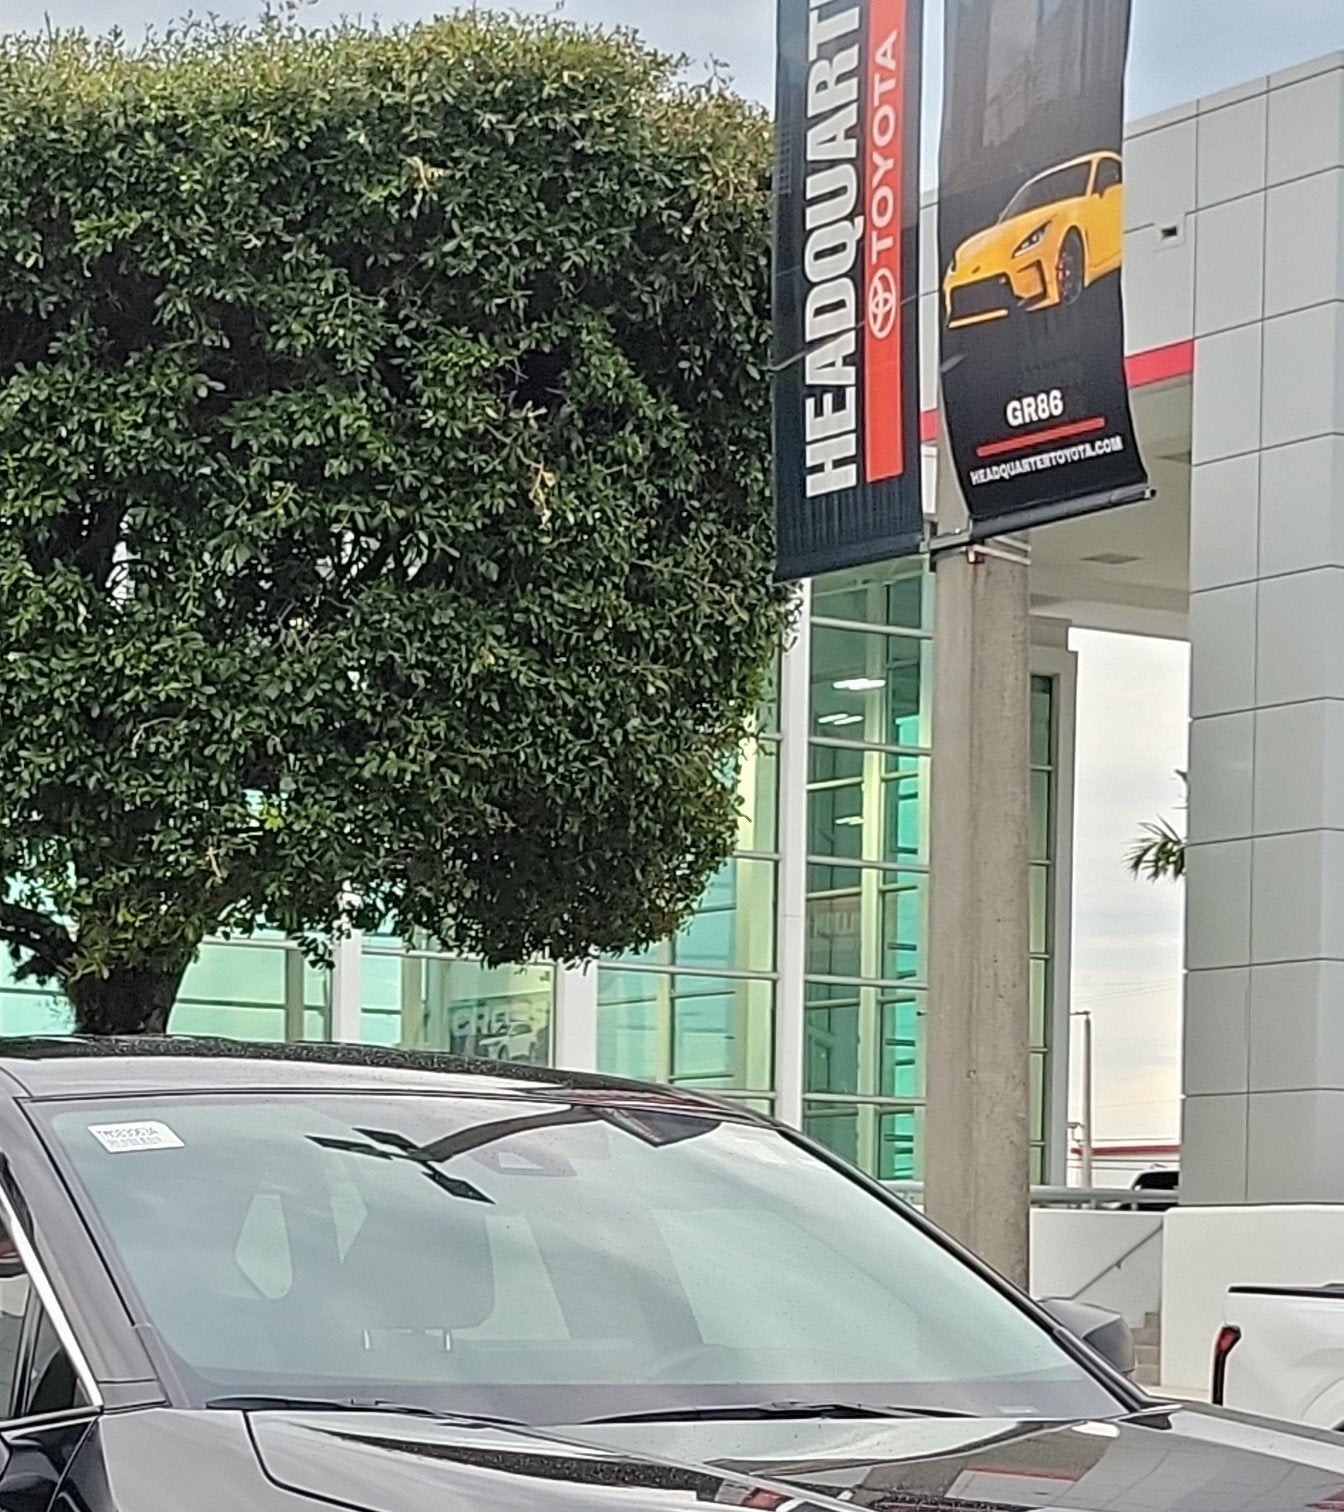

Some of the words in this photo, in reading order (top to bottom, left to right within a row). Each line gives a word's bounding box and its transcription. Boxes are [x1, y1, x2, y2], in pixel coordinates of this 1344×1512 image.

[870, 29, 899, 264] TOYOTA
[804, 0, 865, 498] HEADQUART
[969, 435, 1125, 486] HEADQUARTERTOYOTA.COM
[1006, 389, 1065, 427] GR86
